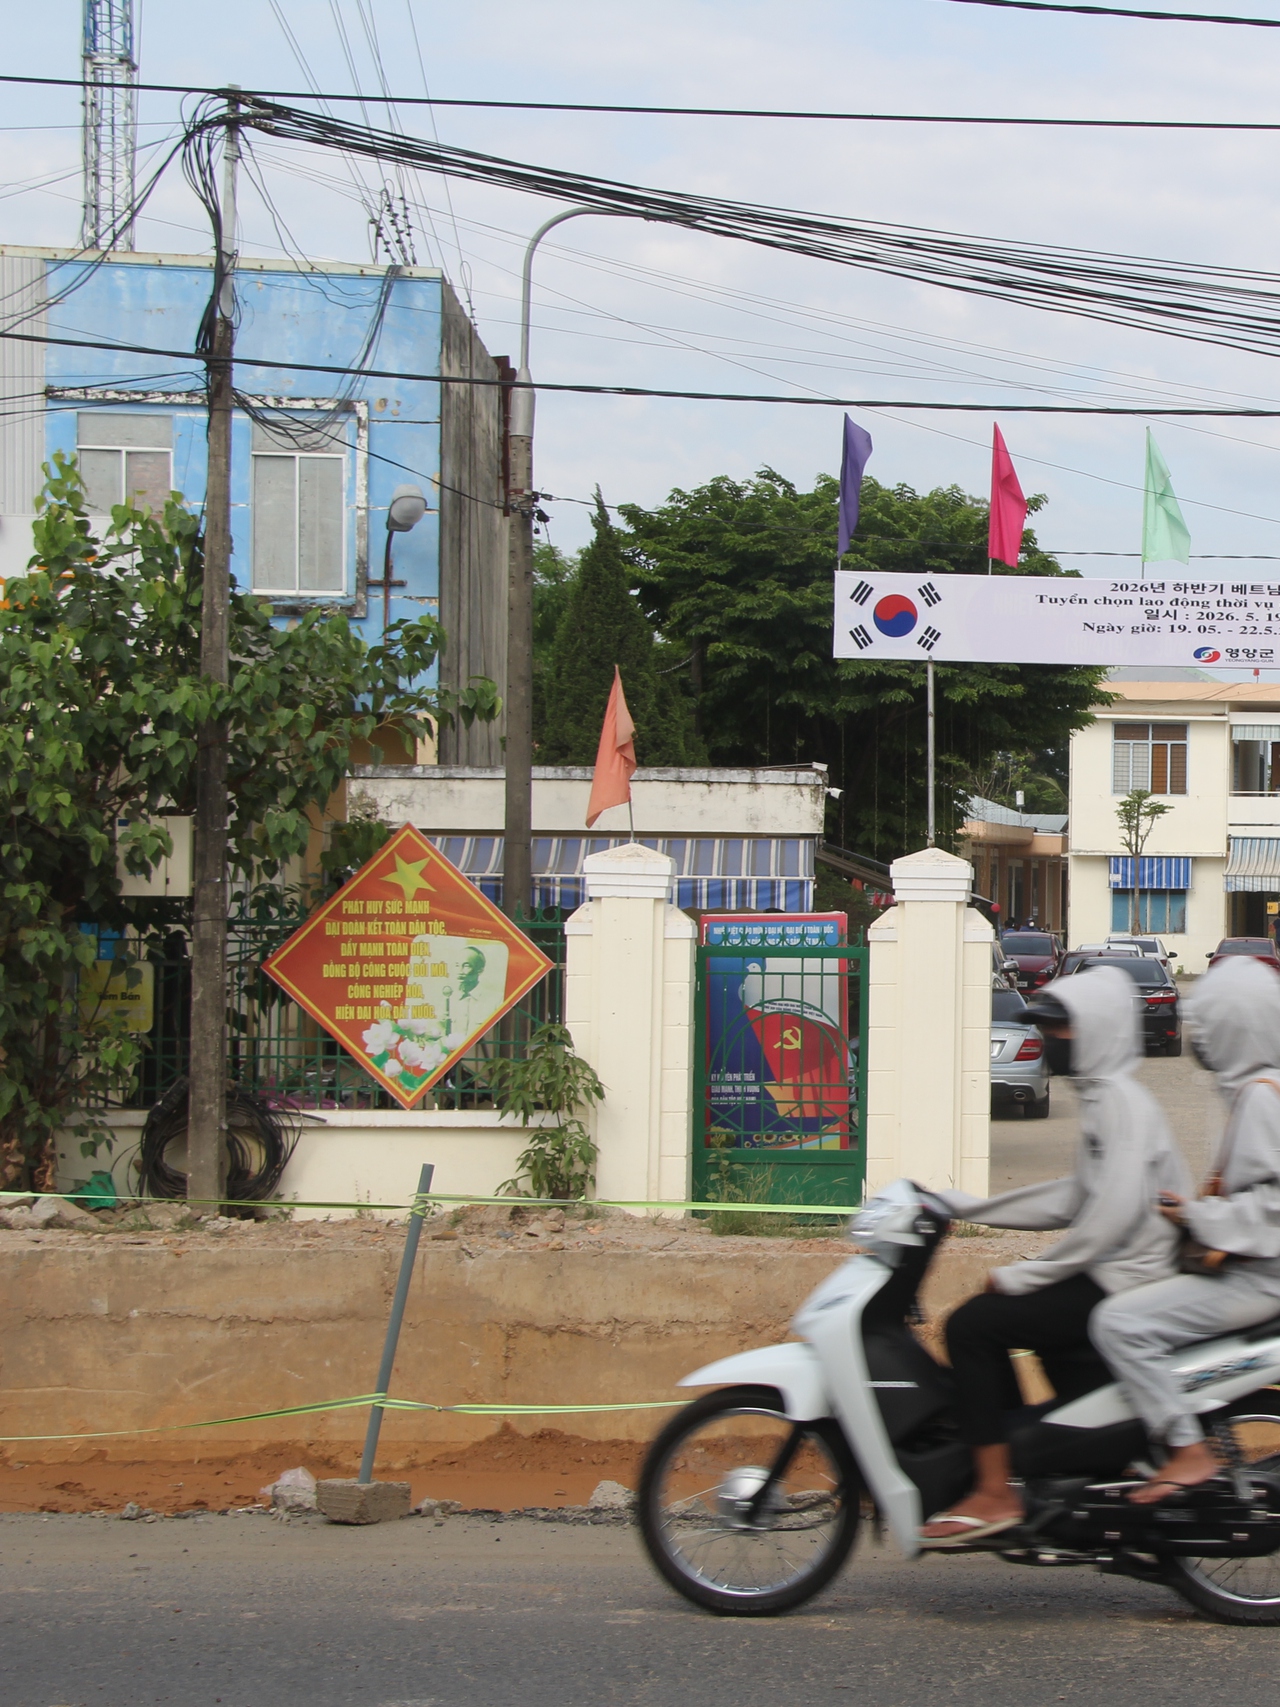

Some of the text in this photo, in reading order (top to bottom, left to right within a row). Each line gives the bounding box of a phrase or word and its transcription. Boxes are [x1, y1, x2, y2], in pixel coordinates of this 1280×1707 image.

[1110, 582, 1166, 594] 2026년
[1172, 582, 1224, 595] 하반기
[1035, 594, 1088, 606] Tuyển
[1094, 596, 1133, 608] chọn
[1139, 597, 1164, 606] lao
[1169, 597, 1210, 609] động
[1216, 598, 1248, 609] thời
[1254, 601, 1274, 611] vụ
[1144, 609, 1178, 621] 일시
[1196, 611, 1240, 622] 2026.
[1245, 613, 1259, 622] 5.
[1082, 622, 1125, 634] Ngày
[1131, 623, 1162, 634] giờ:
[1168, 624, 1191, 634] 19.
[1197, 625, 1221, 634] 05.
[1225, 648, 1274, 659] 영양군
[342, 899, 430, 917] PHÁT HUY SỨC MẠNH
[367, 917, 383, 935] KẾT
[409, 919, 426, 935] DÂN
[360, 942, 384, 958] MẠNH
[386, 941, 408, 956] TOÀN
[348, 961, 361, 980] BỘ
[363, 961, 386, 977] CÔNG
[388, 961, 410, 980] CUỘC
[348, 982, 371, 998] CÔNG
[373, 982, 404, 1000] NGHIỆP
[335, 1003, 355, 1022] HIỆN
